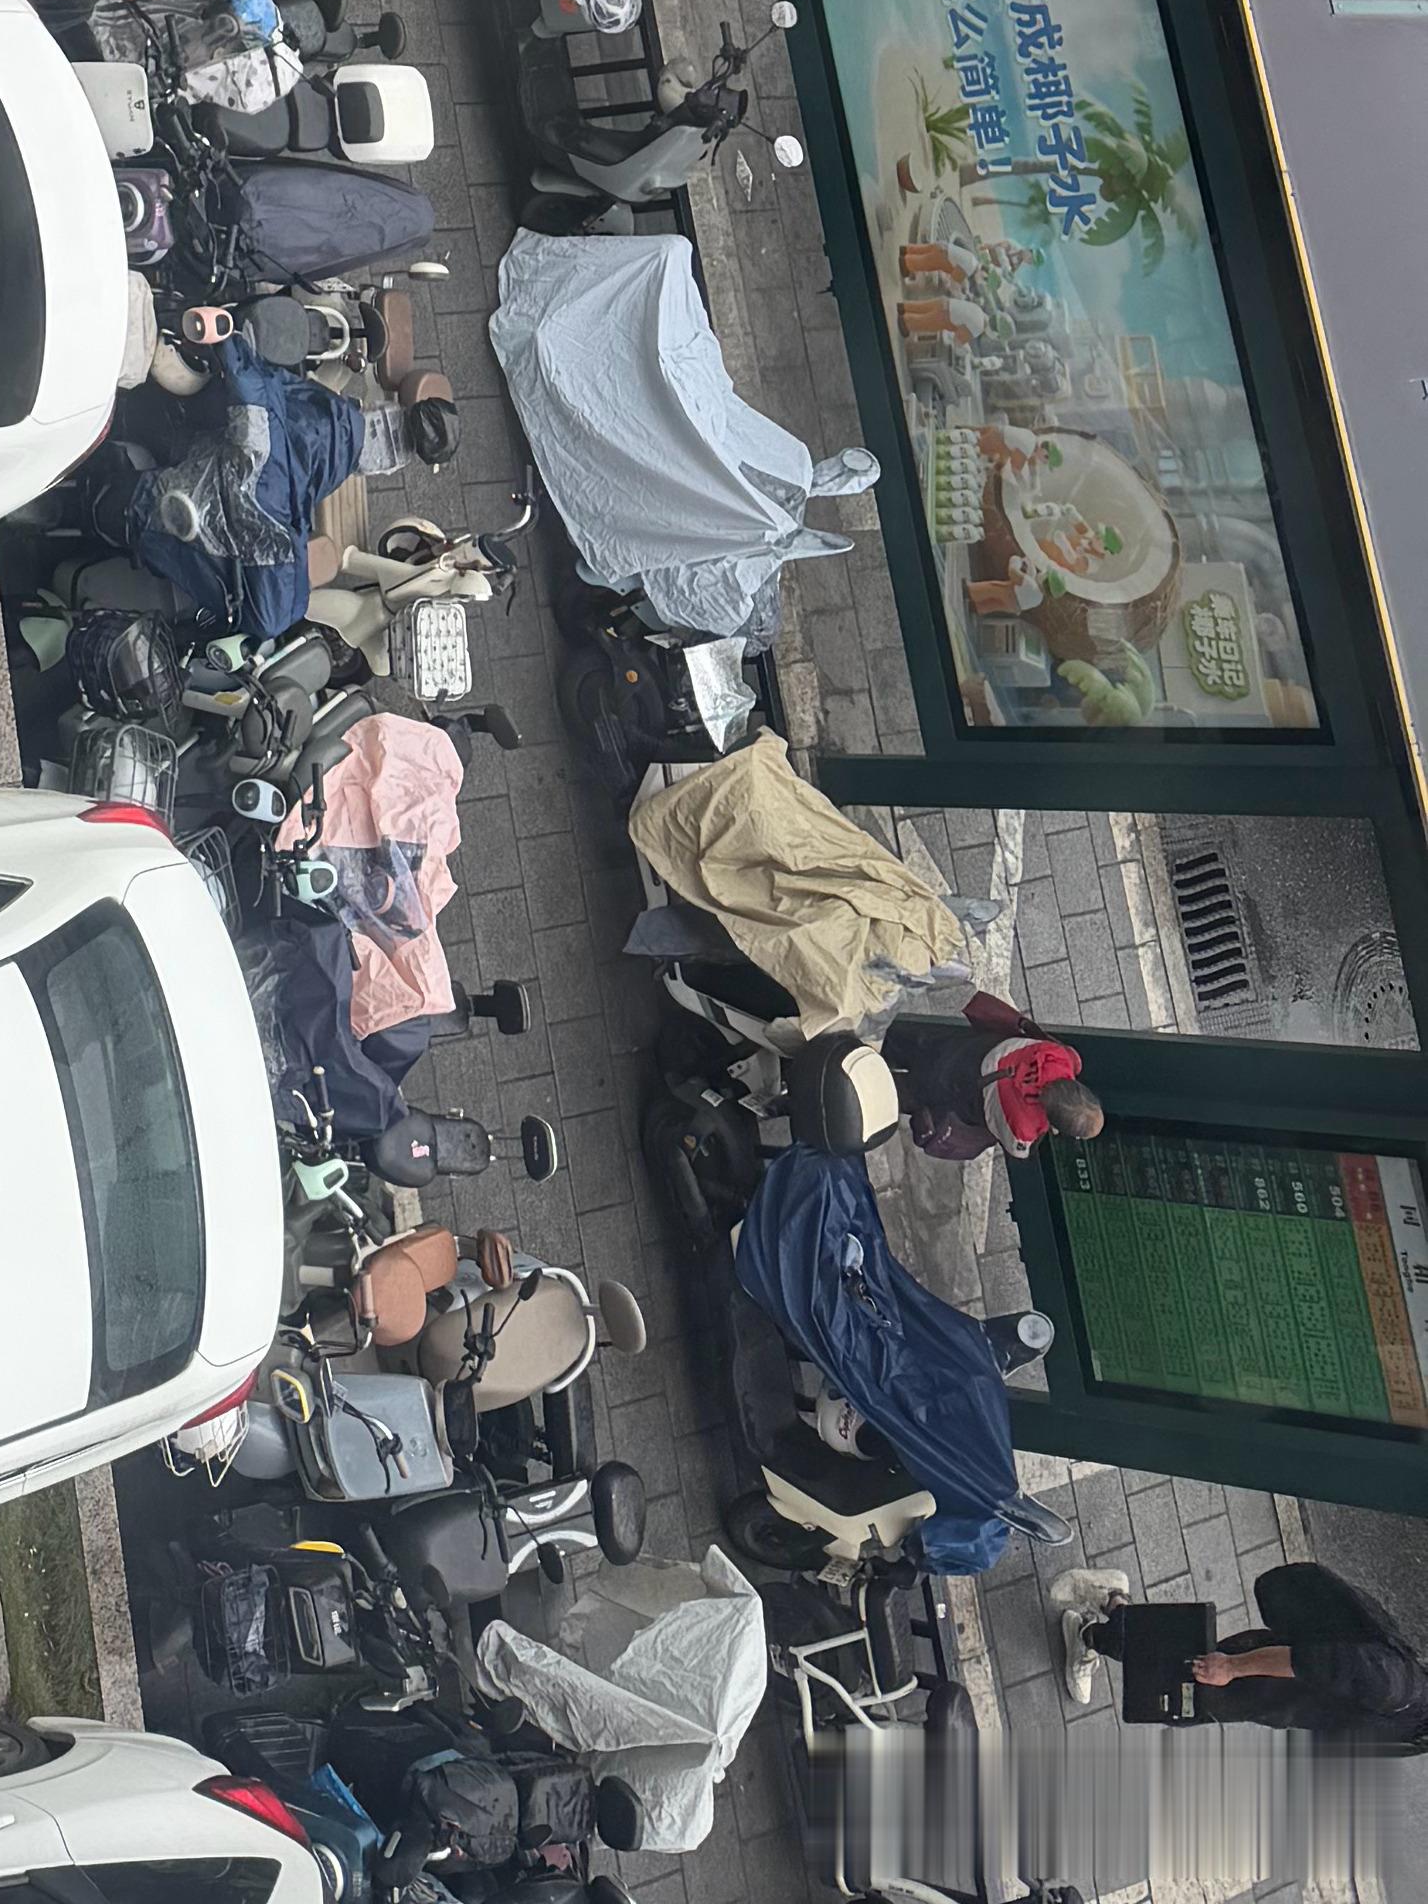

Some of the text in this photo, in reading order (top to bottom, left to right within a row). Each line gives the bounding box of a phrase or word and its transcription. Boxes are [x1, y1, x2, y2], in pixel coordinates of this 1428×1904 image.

[1188, 605, 1222, 685] 椰子水
[1253, 1176, 1271, 1211] 862
[1328, 1184, 1346, 1219] 504
